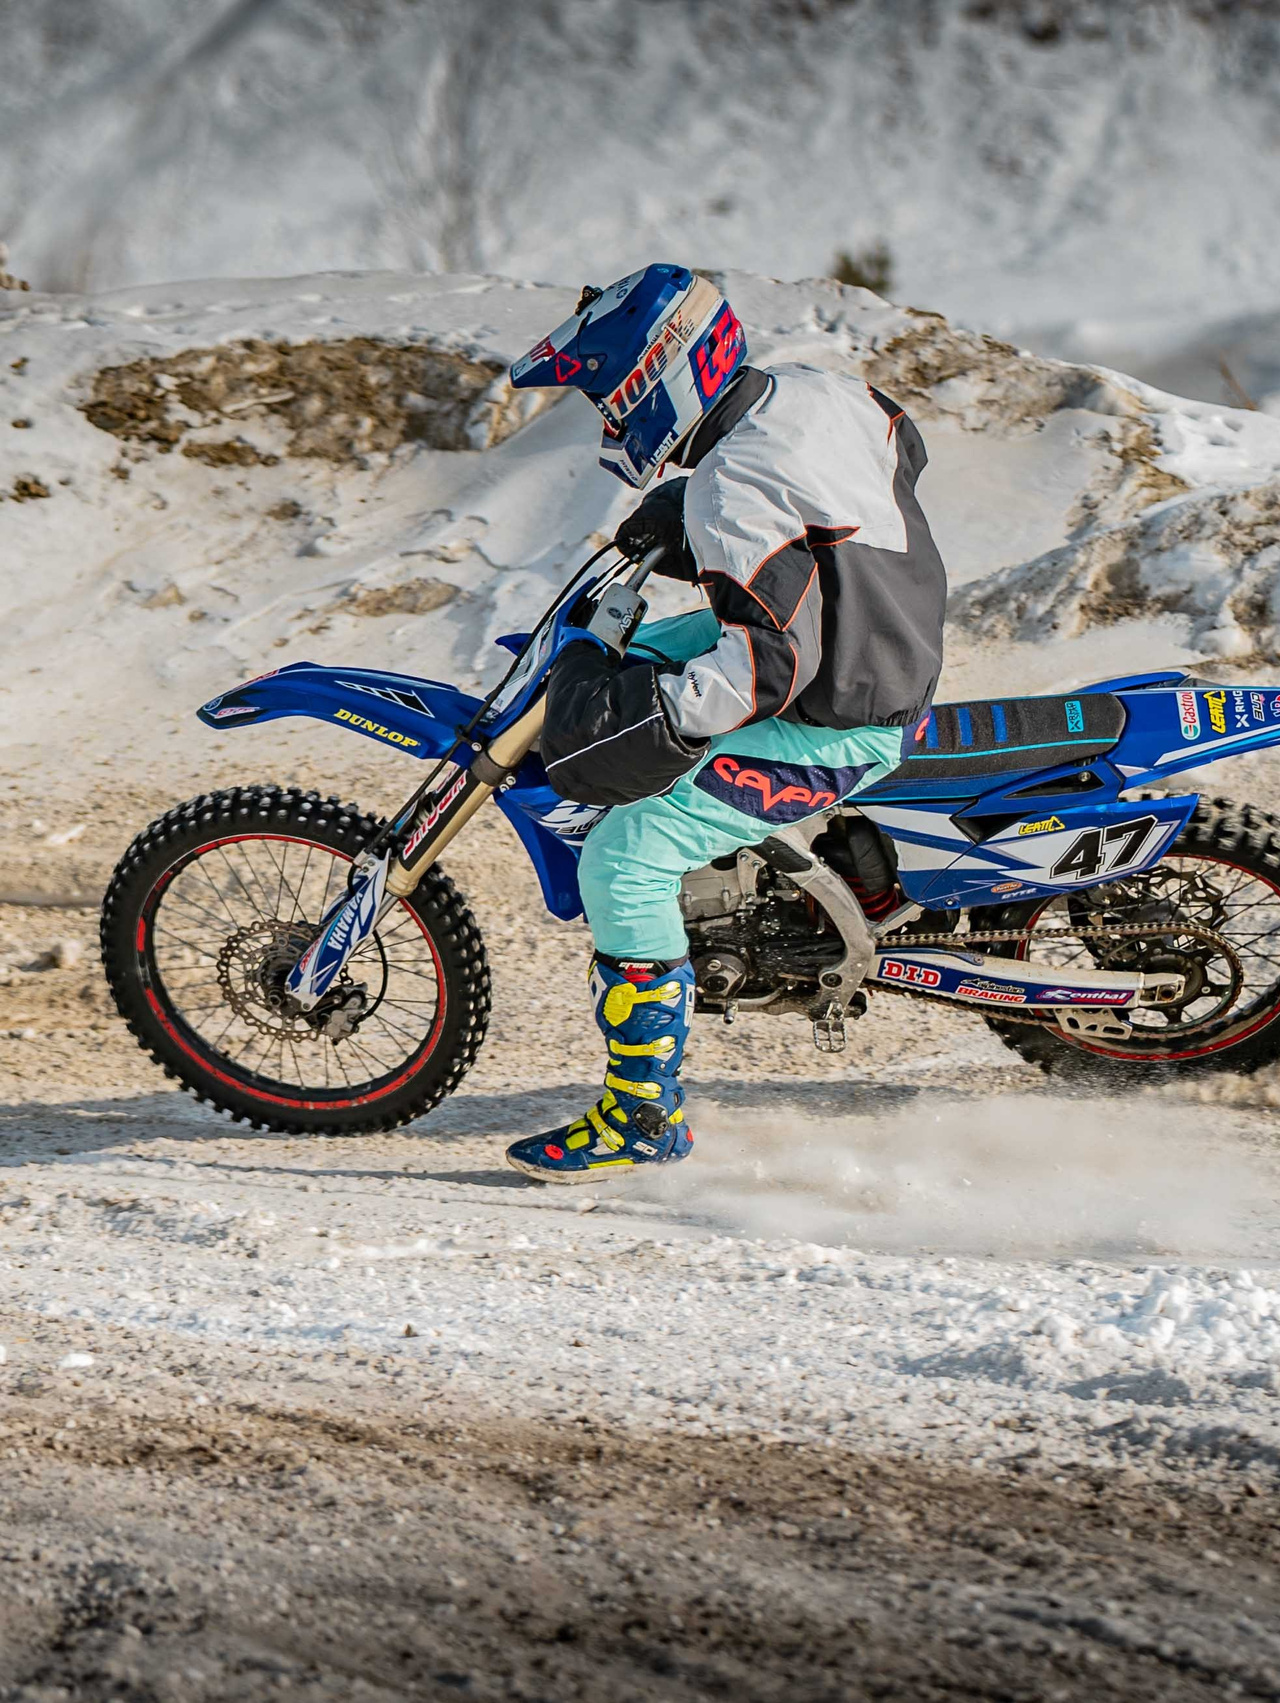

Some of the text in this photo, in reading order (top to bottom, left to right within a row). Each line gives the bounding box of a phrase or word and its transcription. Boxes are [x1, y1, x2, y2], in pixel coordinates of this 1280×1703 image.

[1182, 691, 1197, 724] Castrol
[333, 708, 418, 746] DUNLOP
[1051, 815, 1157, 879] 47
[327, 889, 364, 951] YAMAHA
[957, 986, 1026, 1003] BRAKING
